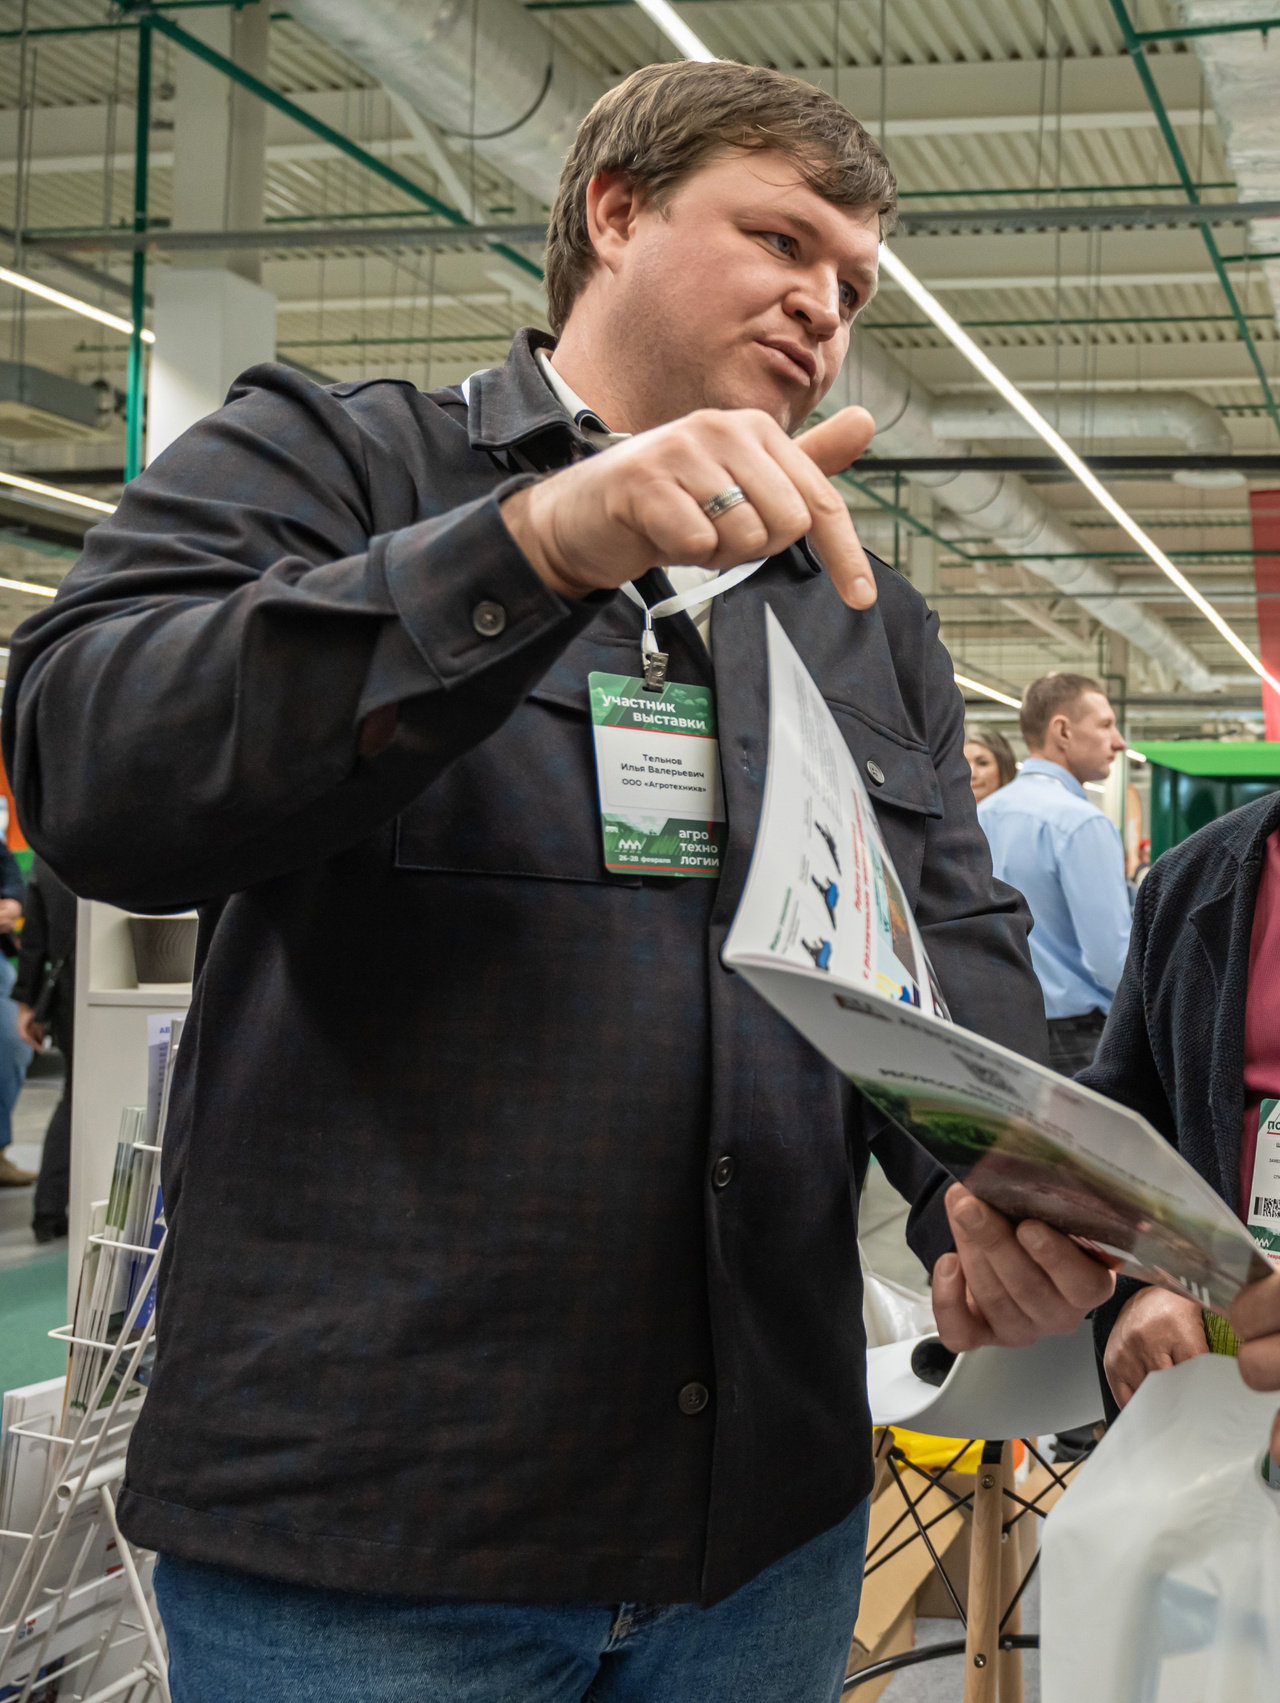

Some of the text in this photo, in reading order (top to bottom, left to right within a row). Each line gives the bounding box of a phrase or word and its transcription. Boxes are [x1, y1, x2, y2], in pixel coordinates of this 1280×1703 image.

[602, 694, 676, 713] участник
[633, 711, 706, 730] выставки
[642, 754, 683, 766] Тельнов
[621, 763, 705, 779] Илья Валерьевич
[622, 778, 642, 787] ООО
[679, 829, 709, 841] агро
[680, 842, 718, 854] техно
[618, 854, 671, 865] 26-28 февраля
[680, 855, 719, 867] логии
